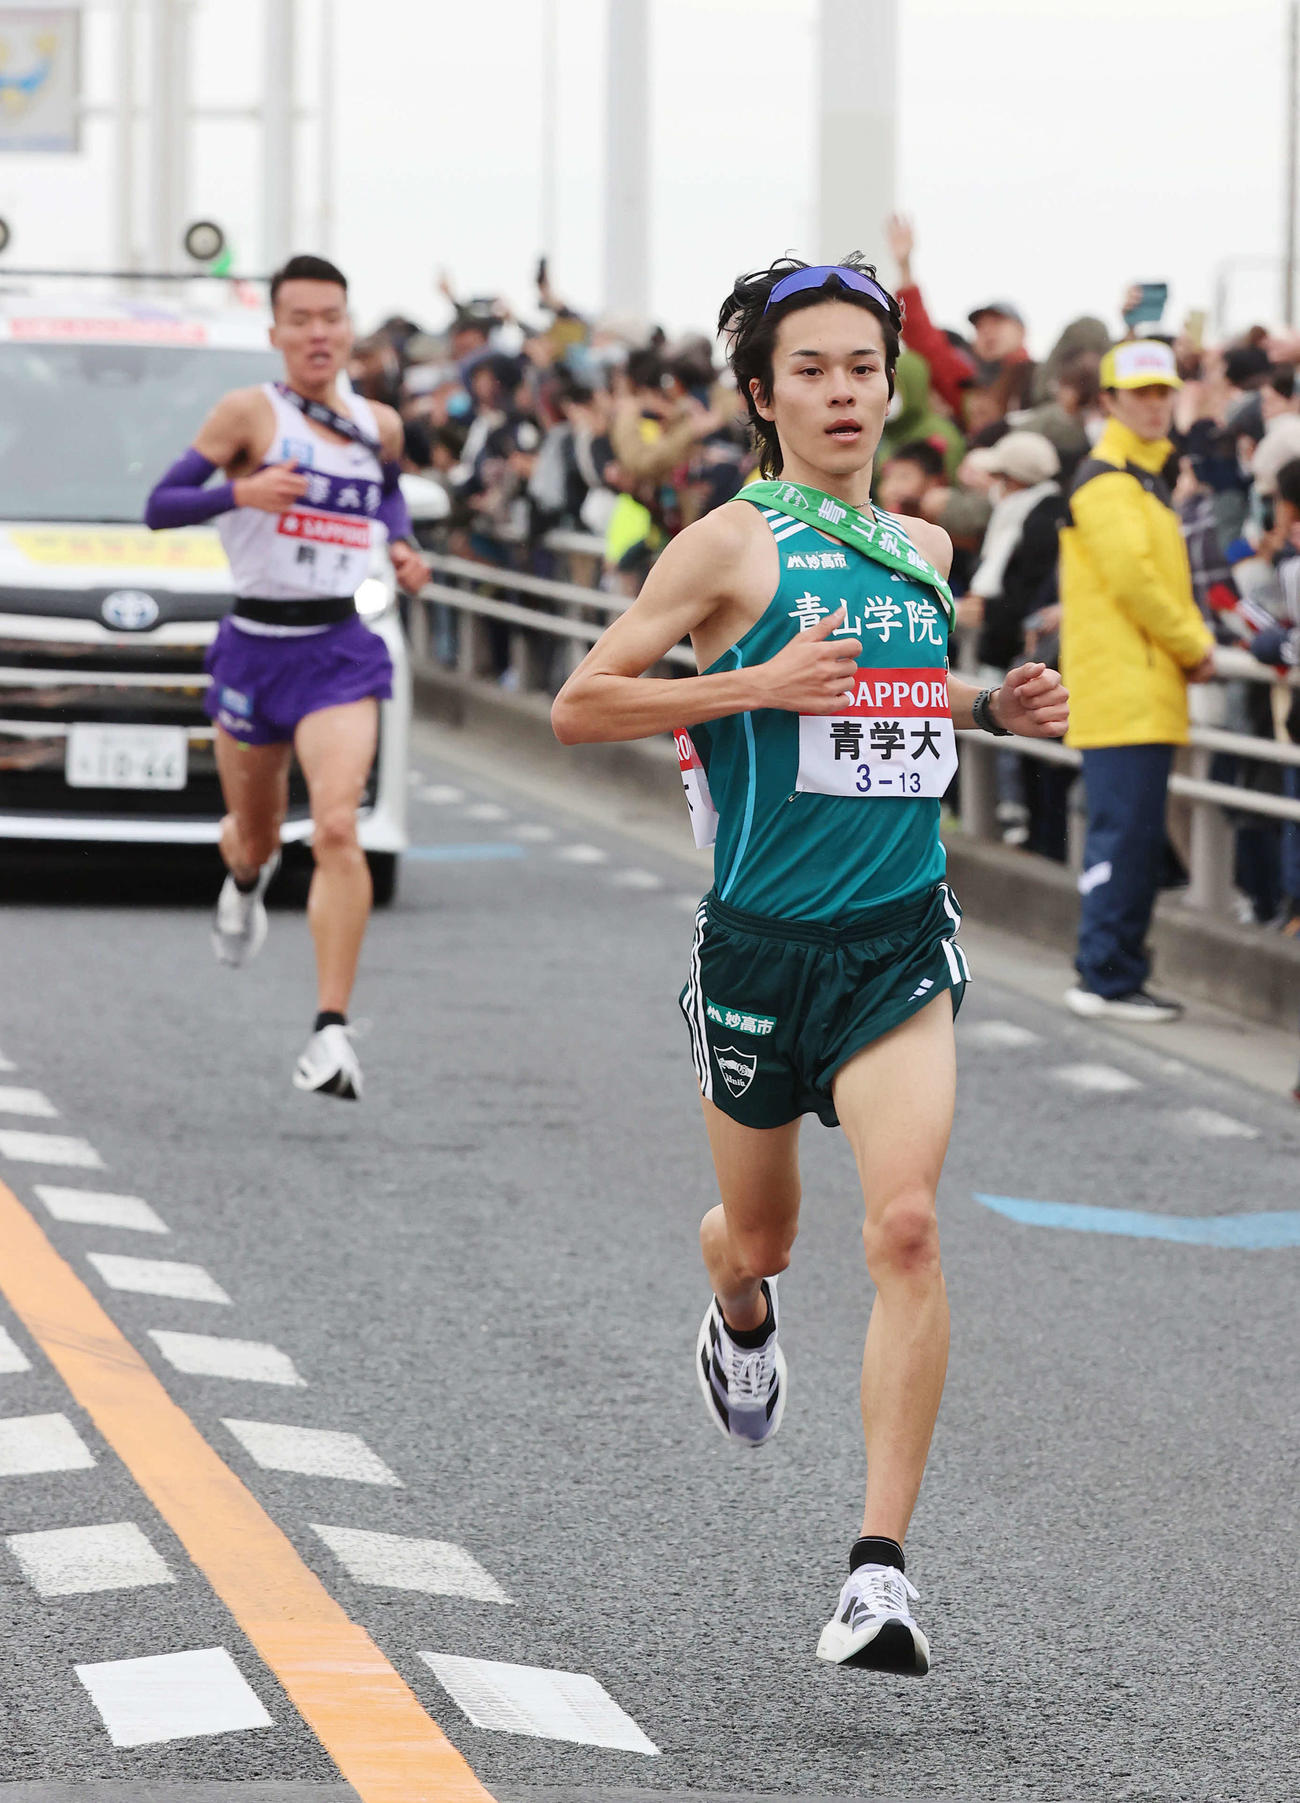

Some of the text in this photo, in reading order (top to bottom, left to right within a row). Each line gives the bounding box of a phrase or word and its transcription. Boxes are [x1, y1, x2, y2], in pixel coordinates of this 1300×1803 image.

[788, 592, 943, 645] 青山学院
[842, 681, 949, 709] APPOR
[829, 721, 941, 760] 青学大
[725, 1011, 775, 1035] 妙高市
